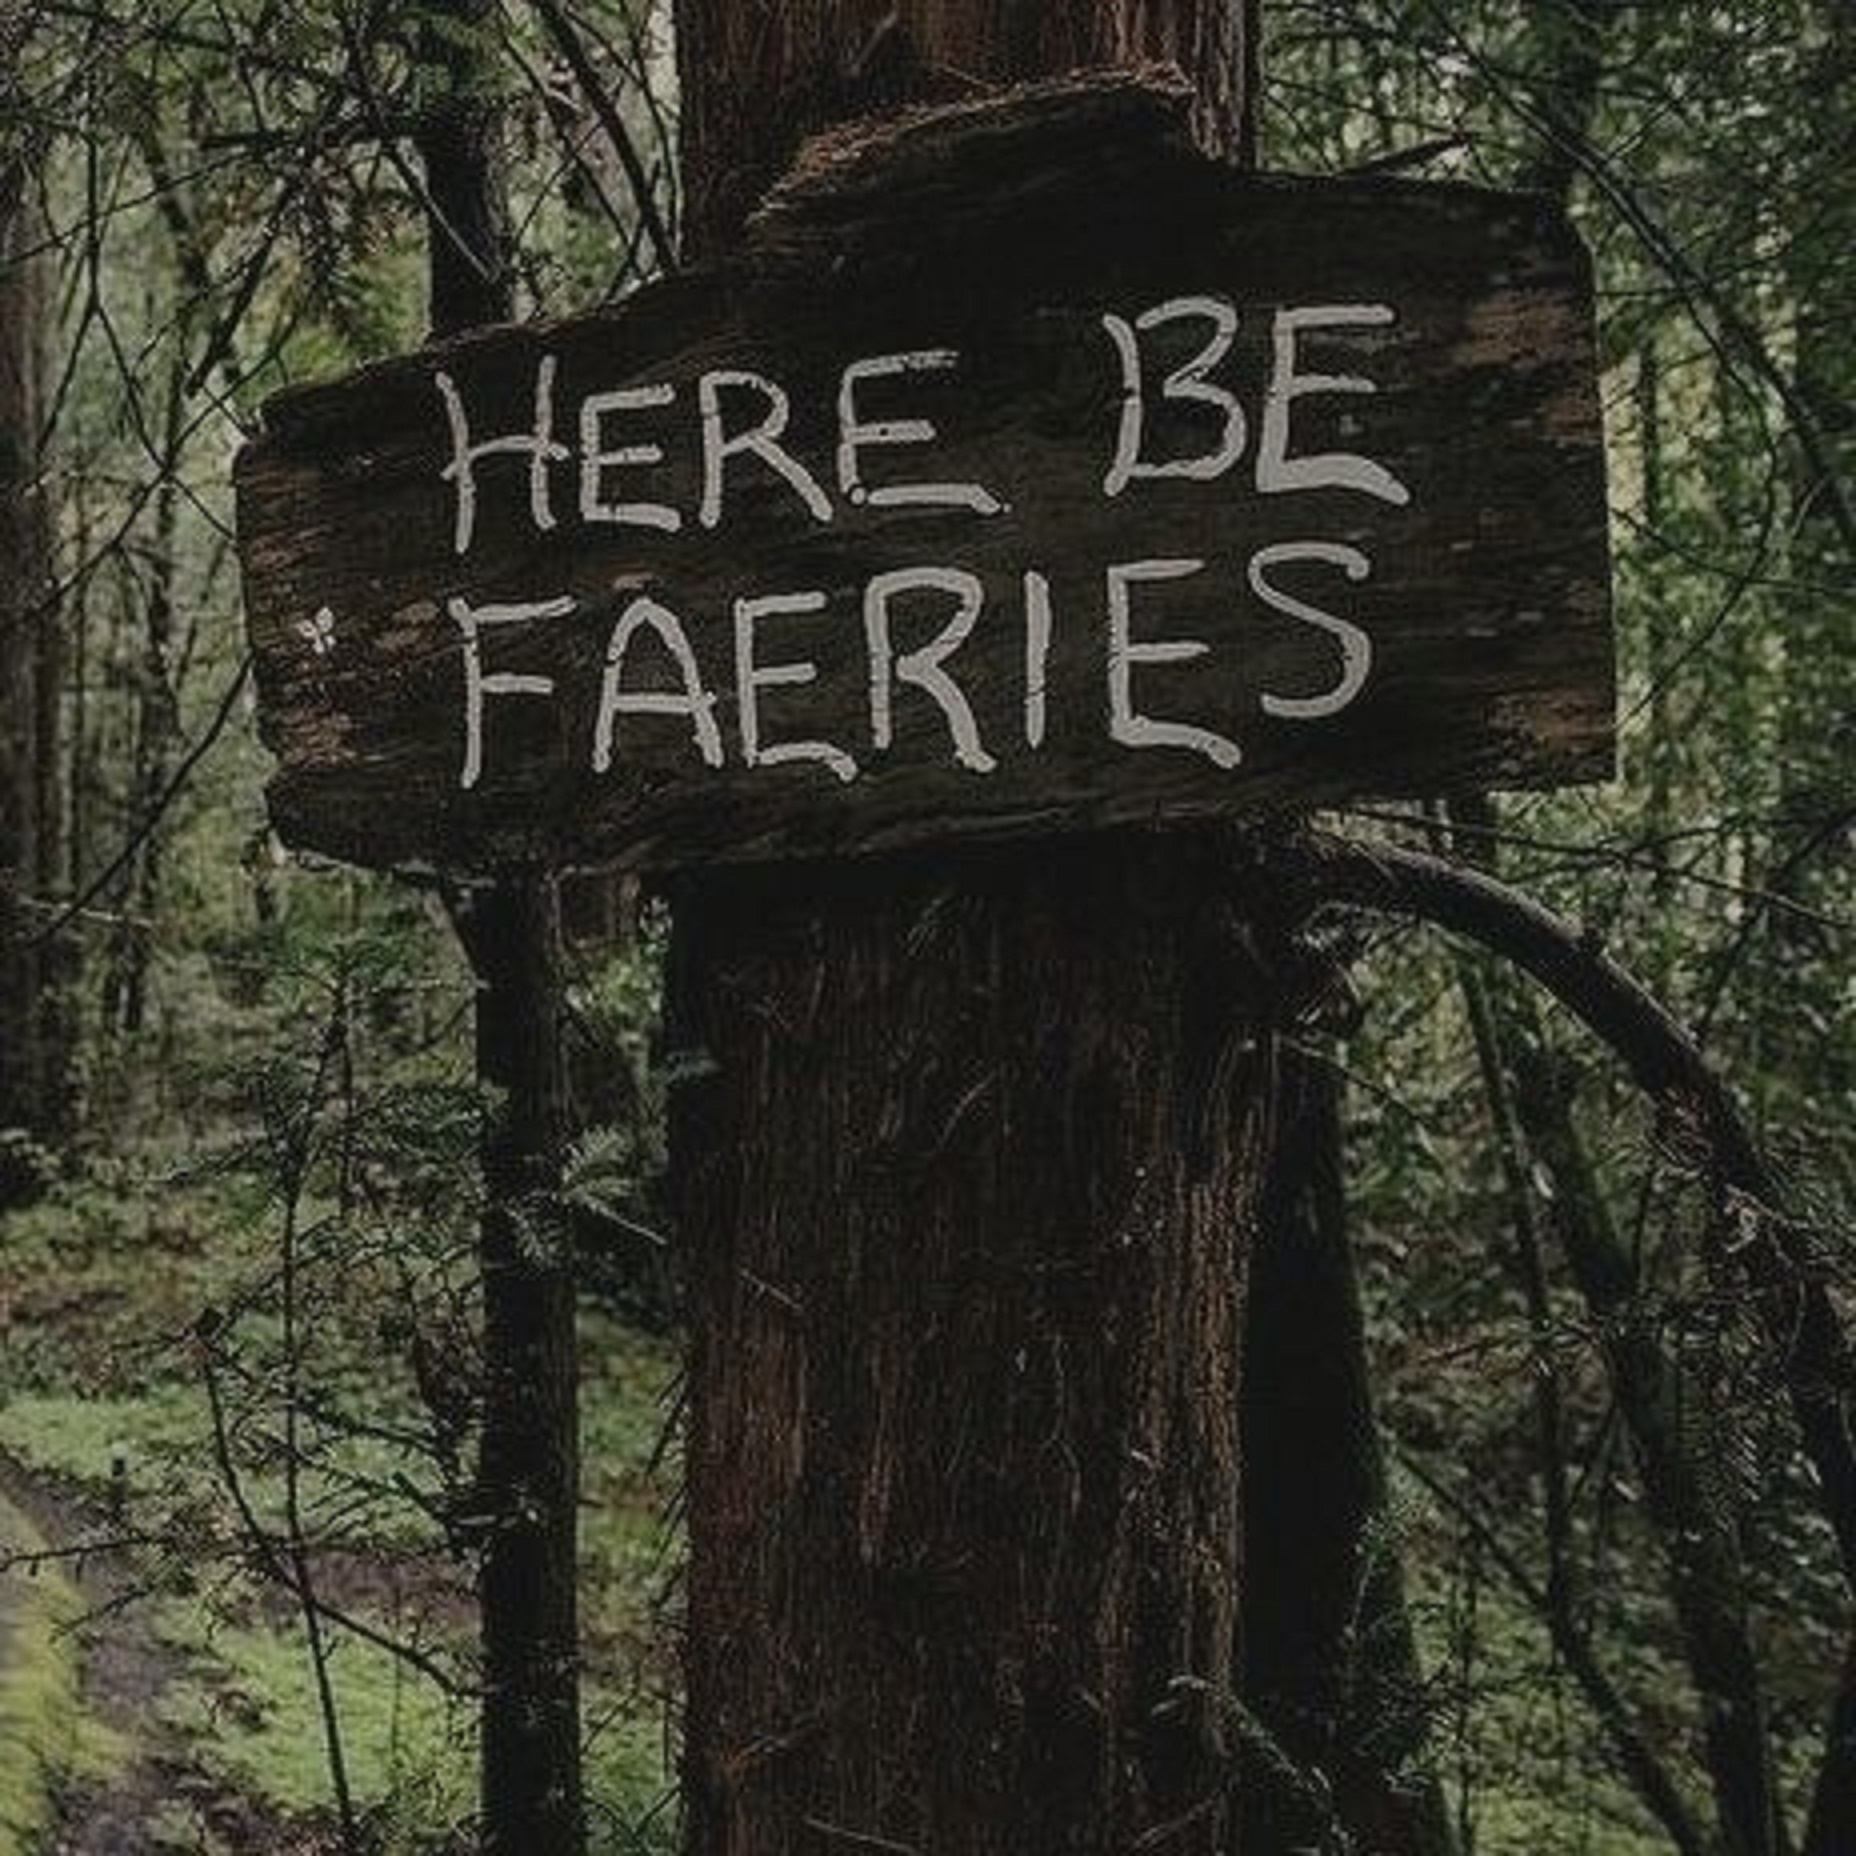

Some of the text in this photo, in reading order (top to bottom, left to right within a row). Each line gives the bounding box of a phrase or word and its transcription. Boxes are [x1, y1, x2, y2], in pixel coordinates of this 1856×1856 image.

[436, 296, 1410, 554] HERE BE
[448, 542, 1373, 789] FAERIES
